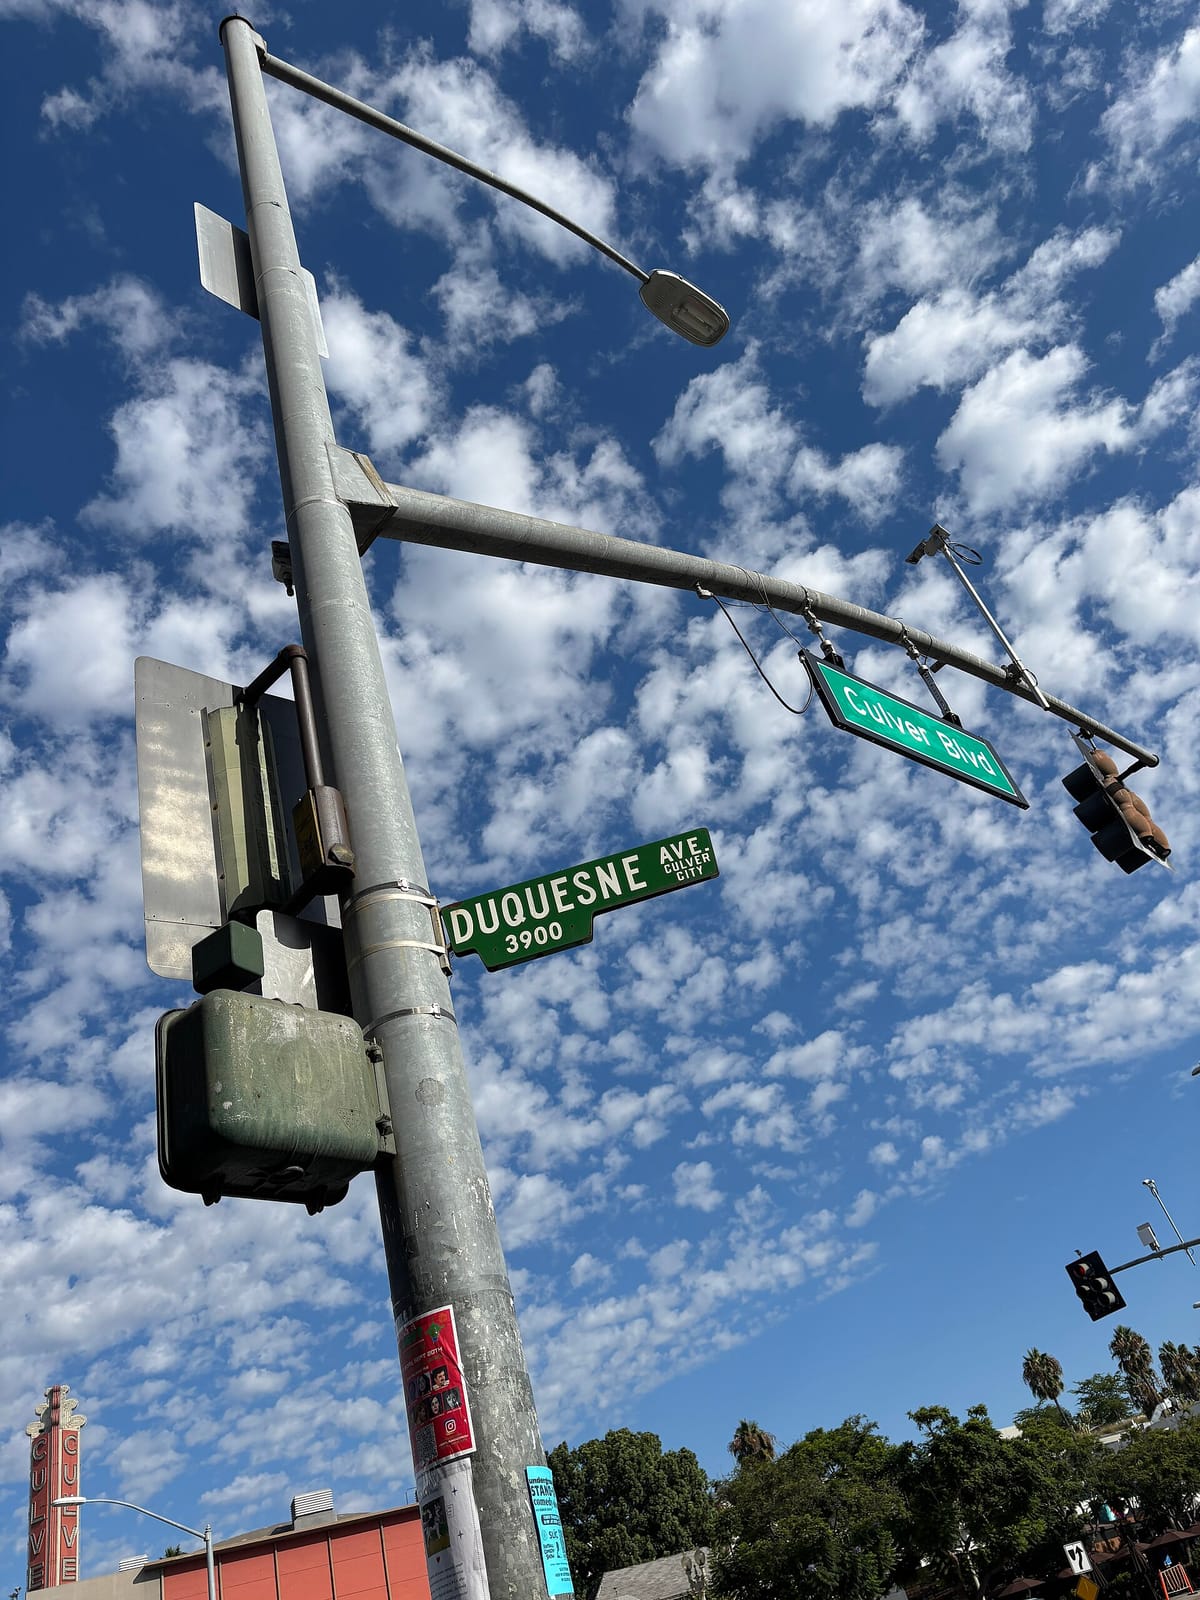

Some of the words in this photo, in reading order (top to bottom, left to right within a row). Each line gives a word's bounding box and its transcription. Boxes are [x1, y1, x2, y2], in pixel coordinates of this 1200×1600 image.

[843, 686, 931, 746] Culver
[935, 730, 997, 777] Blvd
[664, 852, 711, 874] CULVER
[676, 864, 703, 881] CITY
[450, 854, 648, 945] DUQUESNE
[660, 836, 709, 865] AVE.
[505, 921, 563, 954] 3900
